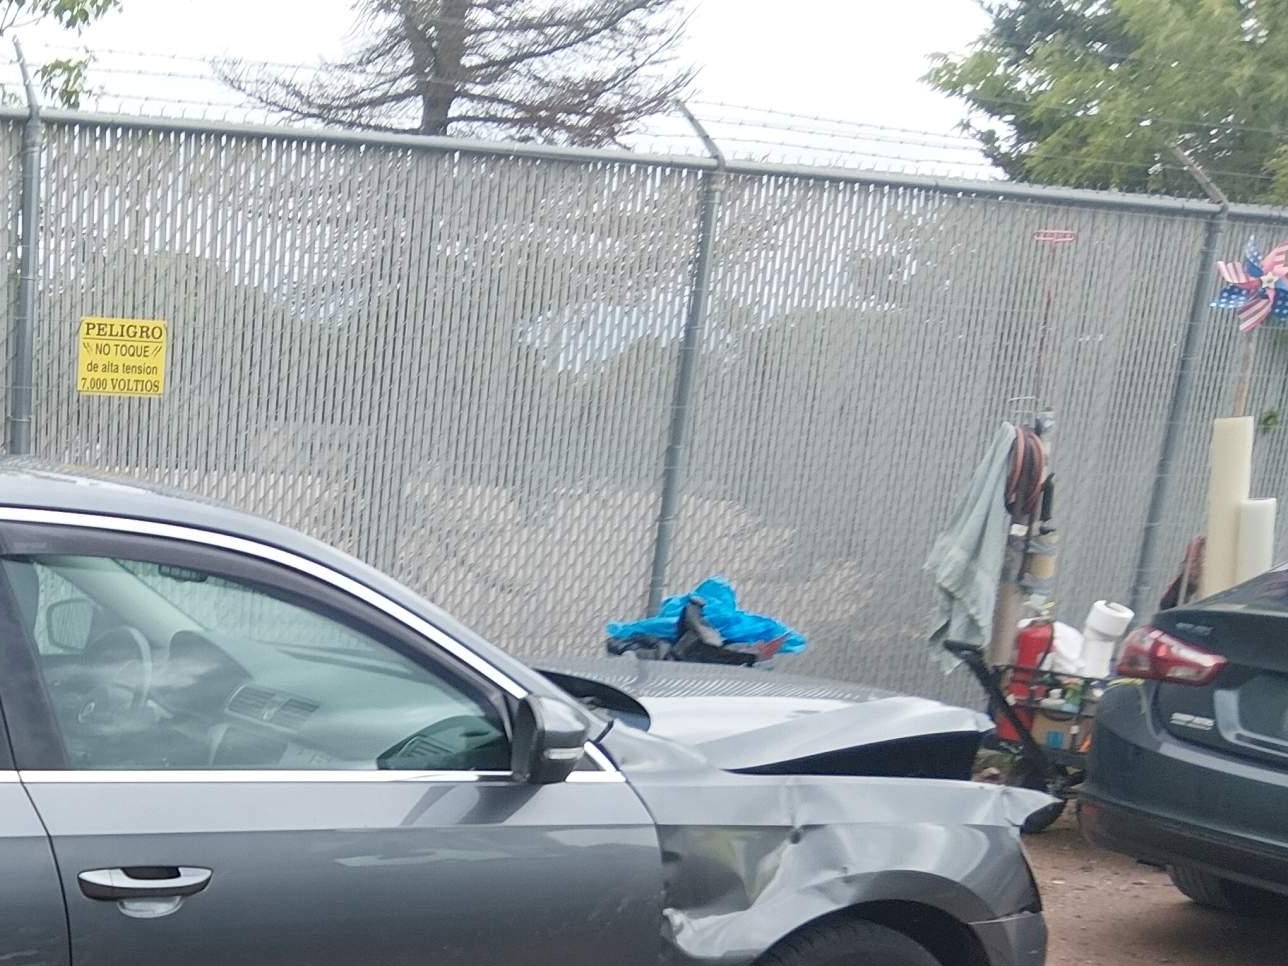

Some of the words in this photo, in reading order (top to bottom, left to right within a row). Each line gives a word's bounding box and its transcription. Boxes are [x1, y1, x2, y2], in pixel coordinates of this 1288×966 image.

[85, 322, 163, 340] PELIGRO
[95, 343, 111, 356] NO
[113, 344, 150, 358] TOQUE
[86, 360, 99, 372] de
[102, 361, 119, 374] alta
[122, 363, 158, 375] tension
[81, 377, 108, 390] 7.000
[111, 378, 160, 393] VOLTIOS
